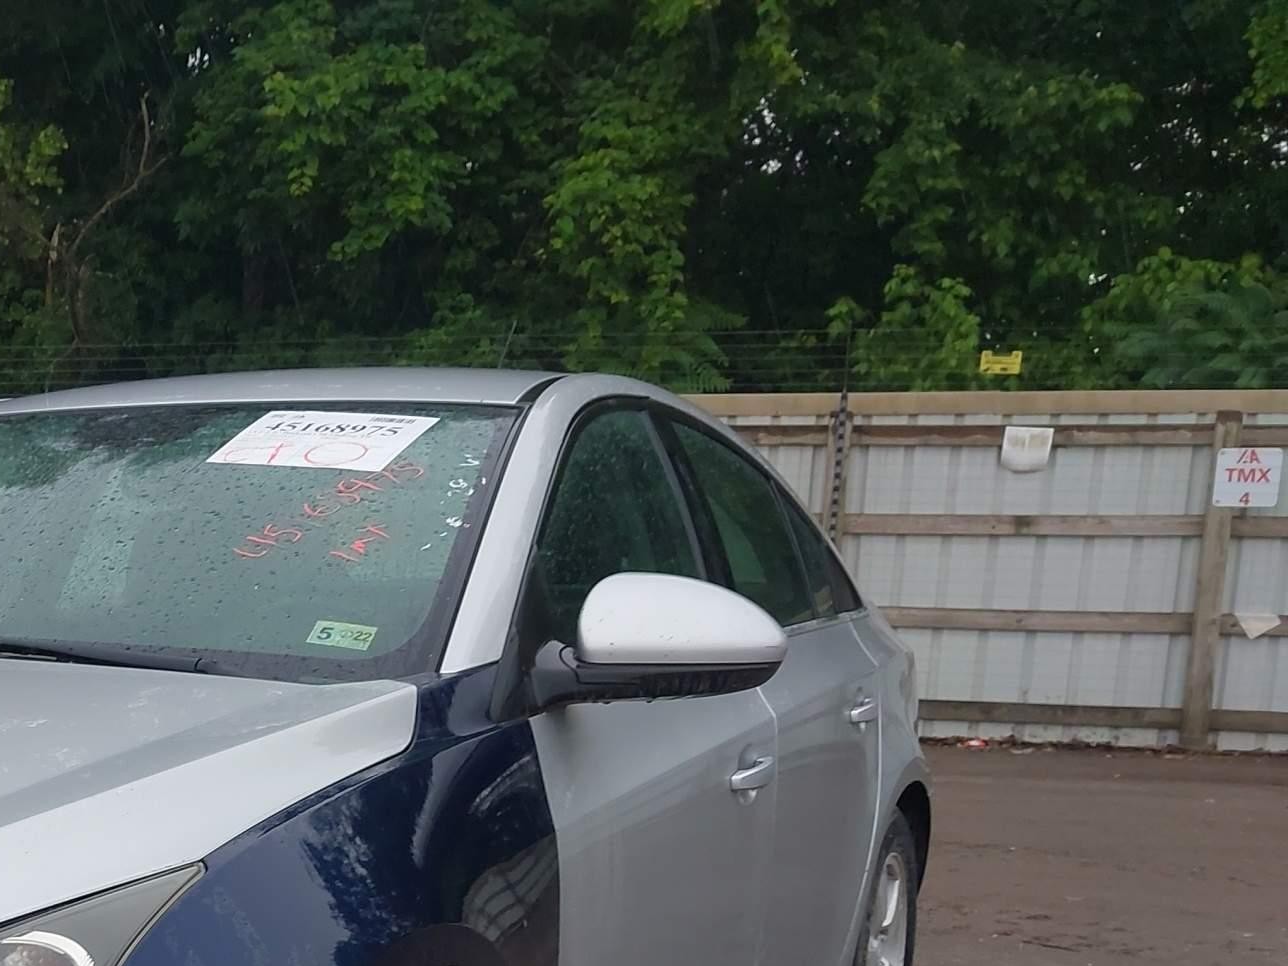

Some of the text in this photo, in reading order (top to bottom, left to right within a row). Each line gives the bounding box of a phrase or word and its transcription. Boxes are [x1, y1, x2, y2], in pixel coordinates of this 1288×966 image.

[265, 421, 404, 437] 45168975
[1224, 467, 1272, 483] TMX
[1239, 491, 1251, 506] 4
[316, 626, 335, 640] 5
